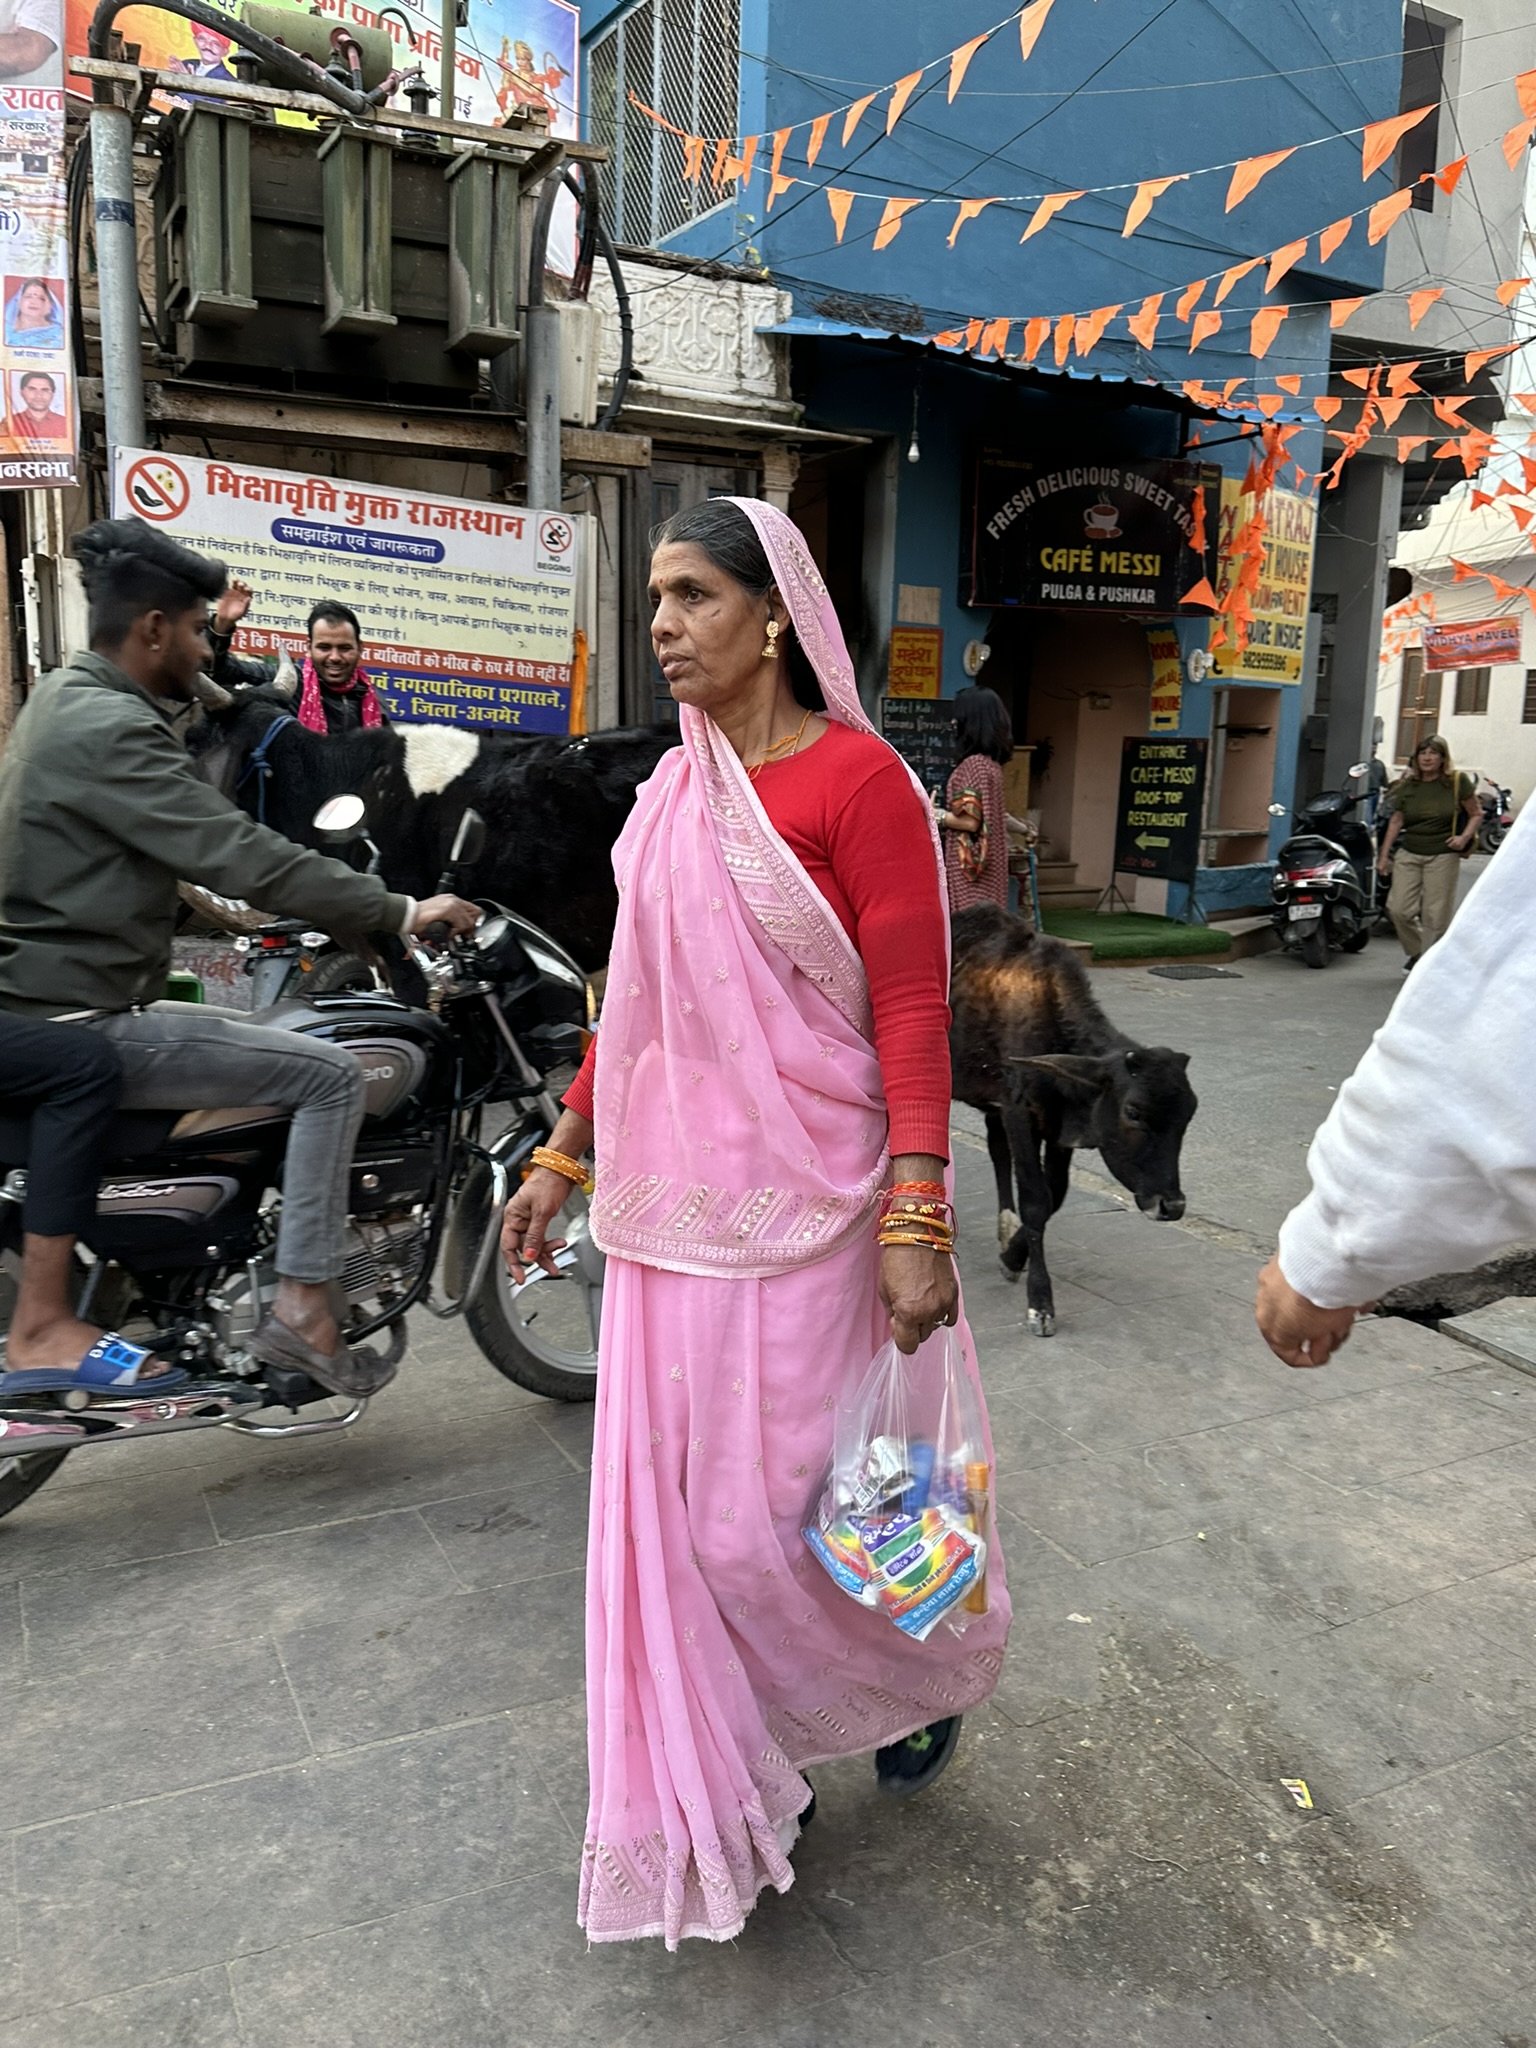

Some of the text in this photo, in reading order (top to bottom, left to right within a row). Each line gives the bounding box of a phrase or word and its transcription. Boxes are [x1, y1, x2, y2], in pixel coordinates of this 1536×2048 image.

[408, 30, 484, 80] प्रतिठा
[2, 87, 64, 112] रावत
[206, 463, 526, 540] भिक्षावृत्ति मुक्त राजस्थान
[986, 467, 1198, 540] FRESH DELICIOUS SWEET TAS
[1260, 497, 1313, 545] ATRAJ
[345, 533, 367, 550] एवं
[369, 536, 437, 558] जागरूकता
[549, 555, 562, 563] NO
[196, 536, 206, 549] से
[208, 538, 242, 553] निवेदन
[243, 541, 251, 555] है
[253, 542, 268, 556] कि
[269, 544, 316, 565] भिक्षावृत्ति
[319, 552, 328, 564] में
[328, 552, 352, 567] लिप्त
[353, 558, 395, 573] व्यक्तियों
[395, 563, 410, 575] को
[455, 573, 470, 584] कर
[471, 572, 492, 587] जिले
[507, 577, 550, 597] भिक्षावृत्ति
[551, 586, 571, 598] मुक्त
[536, 562, 572, 573] BEGGING
[1040, 545, 1161, 576] CAFÉ MESSI
[1274, 548, 1310, 586] HOUSE
[260, 568, 281, 581] द्वारा
[285, 572, 314, 584] समस्त
[317, 574, 351, 592] भिक्षुक
[354, 579, 365, 592] के
[368, 581, 389, 598] लिए
[537, 602, 569, 618] रोजगार
[1041, 583, 1156, 604] PULGA & PUSHKAR
[1251, 584, 1273, 610] OOM
[256, 613, 271, 625] इस
[273, 613, 301, 630] प्रवृत्ति
[376, 629, 392, 639] रहा
[368, 603, 382, 616] की
[384, 605, 399, 619] गई
[414, 608, 439, 626] किन्तु
[472, 618, 490, 630] द्वारा
[491, 618, 523, 635] भिक्षुक
[524, 622, 538, 635] को
[1274, 622, 1303, 650] INSIDE
[237, 629, 248, 649] है
[250, 631, 268, 648] कि
[424, 652, 440, 668] को
[442, 654, 470, 671] भीख
[471, 656, 483, 672] के
[505, 660, 515, 676] में
[517, 661, 535, 678] पैसे
[393, 678, 497, 701] नगरपालिका
[411, 697, 522, 725] जिला-अजमेर
[1139, 745, 1187, 759] ENTRANCE
[1127, 810, 1189, 828] RESTAURENT
[362, 1066, 394, 1082] ero
